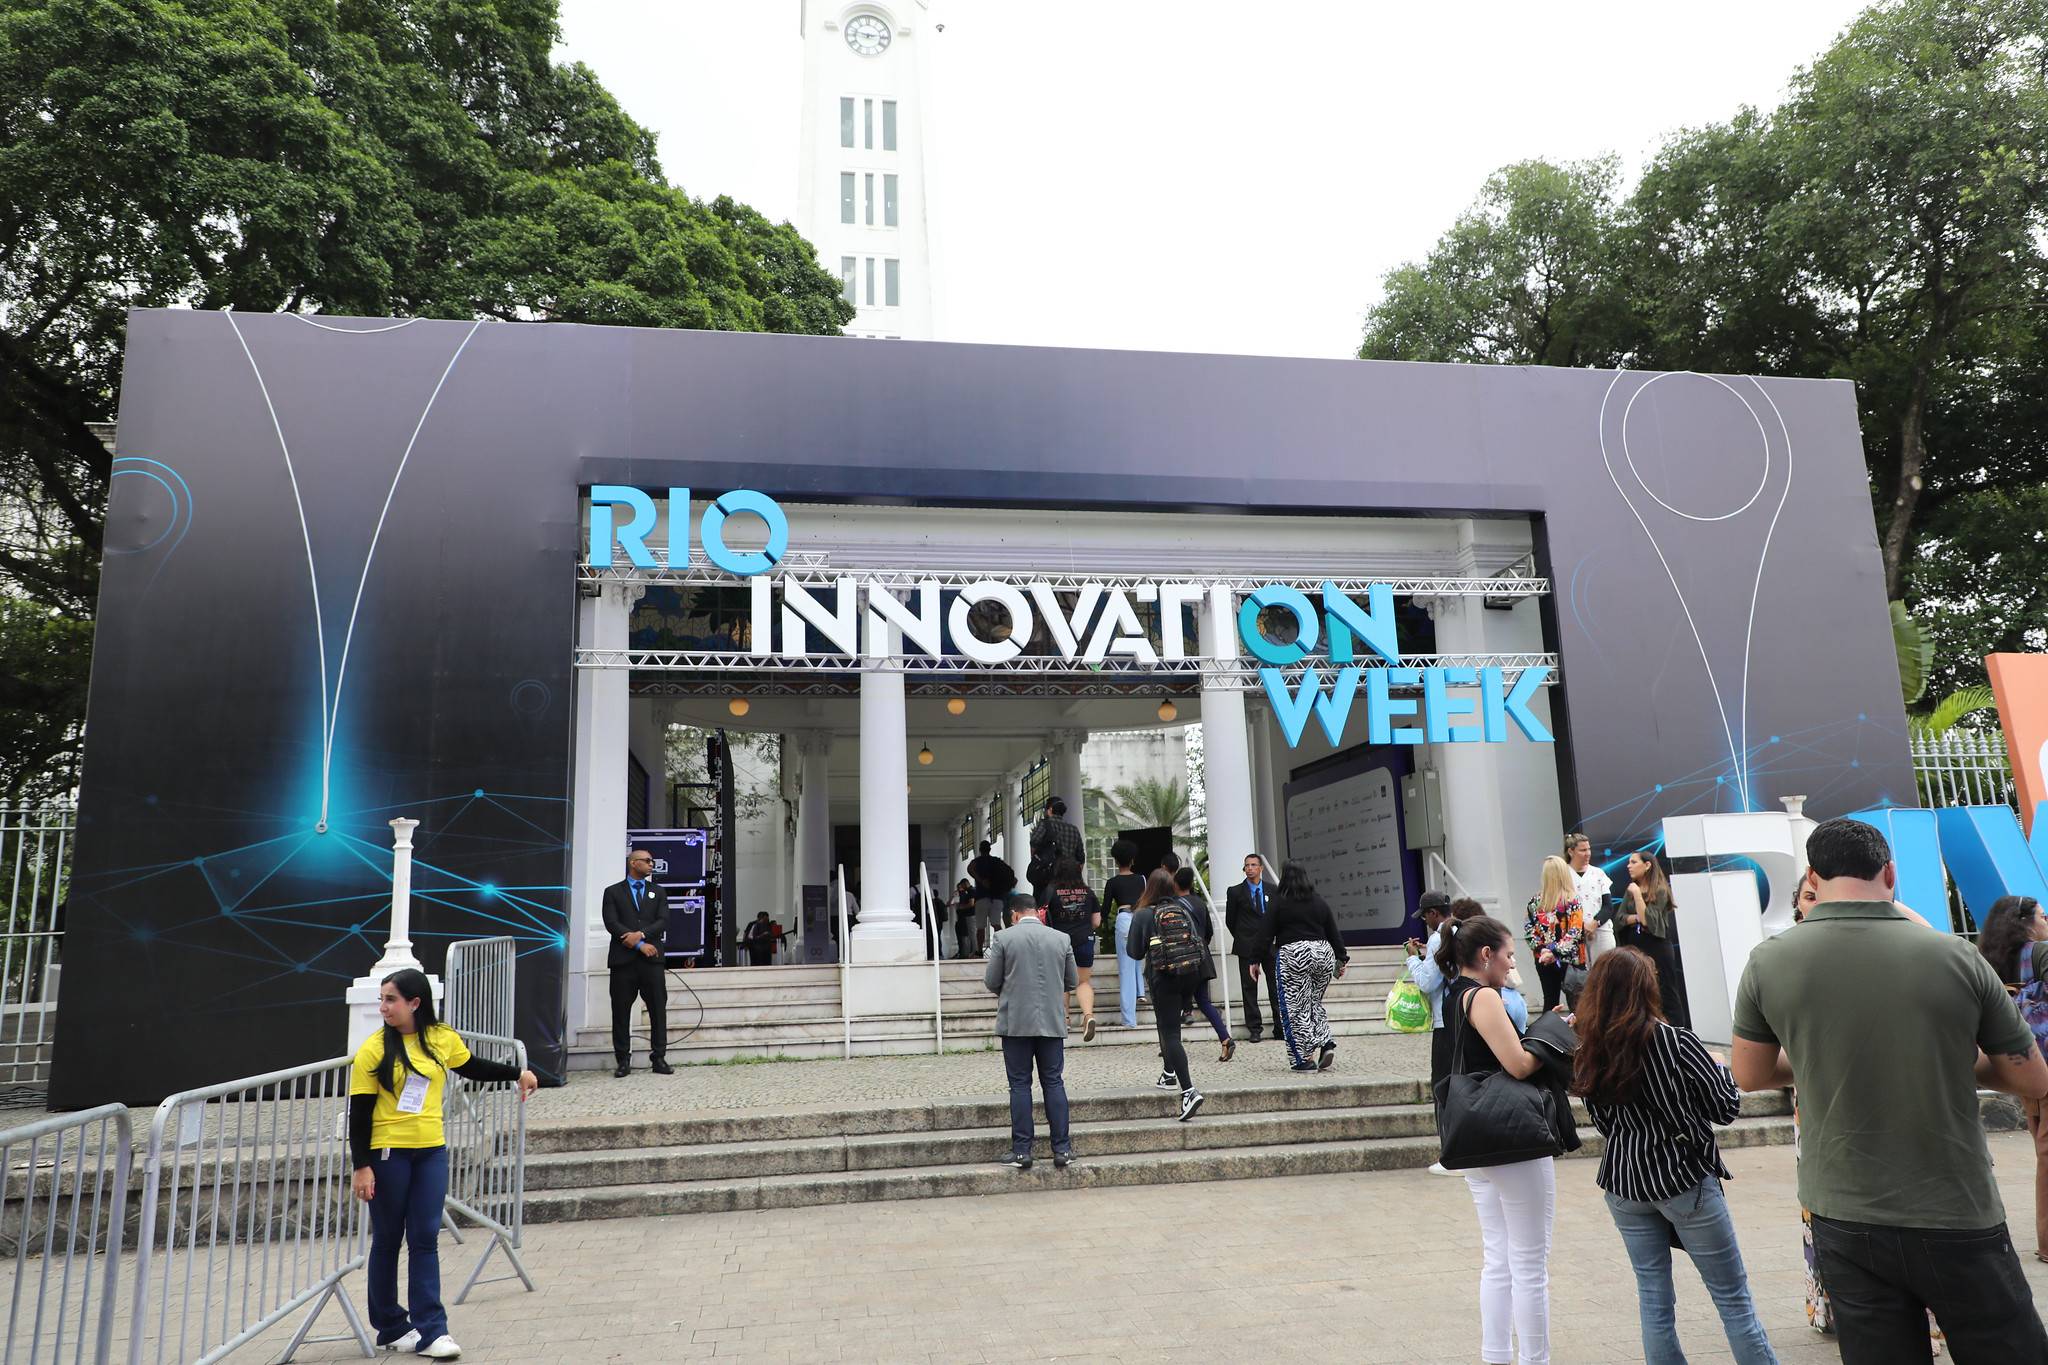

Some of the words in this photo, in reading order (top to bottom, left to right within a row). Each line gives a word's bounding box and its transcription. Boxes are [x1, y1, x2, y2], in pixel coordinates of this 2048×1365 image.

[589, 484, 789, 576] RIO
[750, 576, 1400, 667] INNOVATION
[1258, 665, 1556, 749] WEEK
